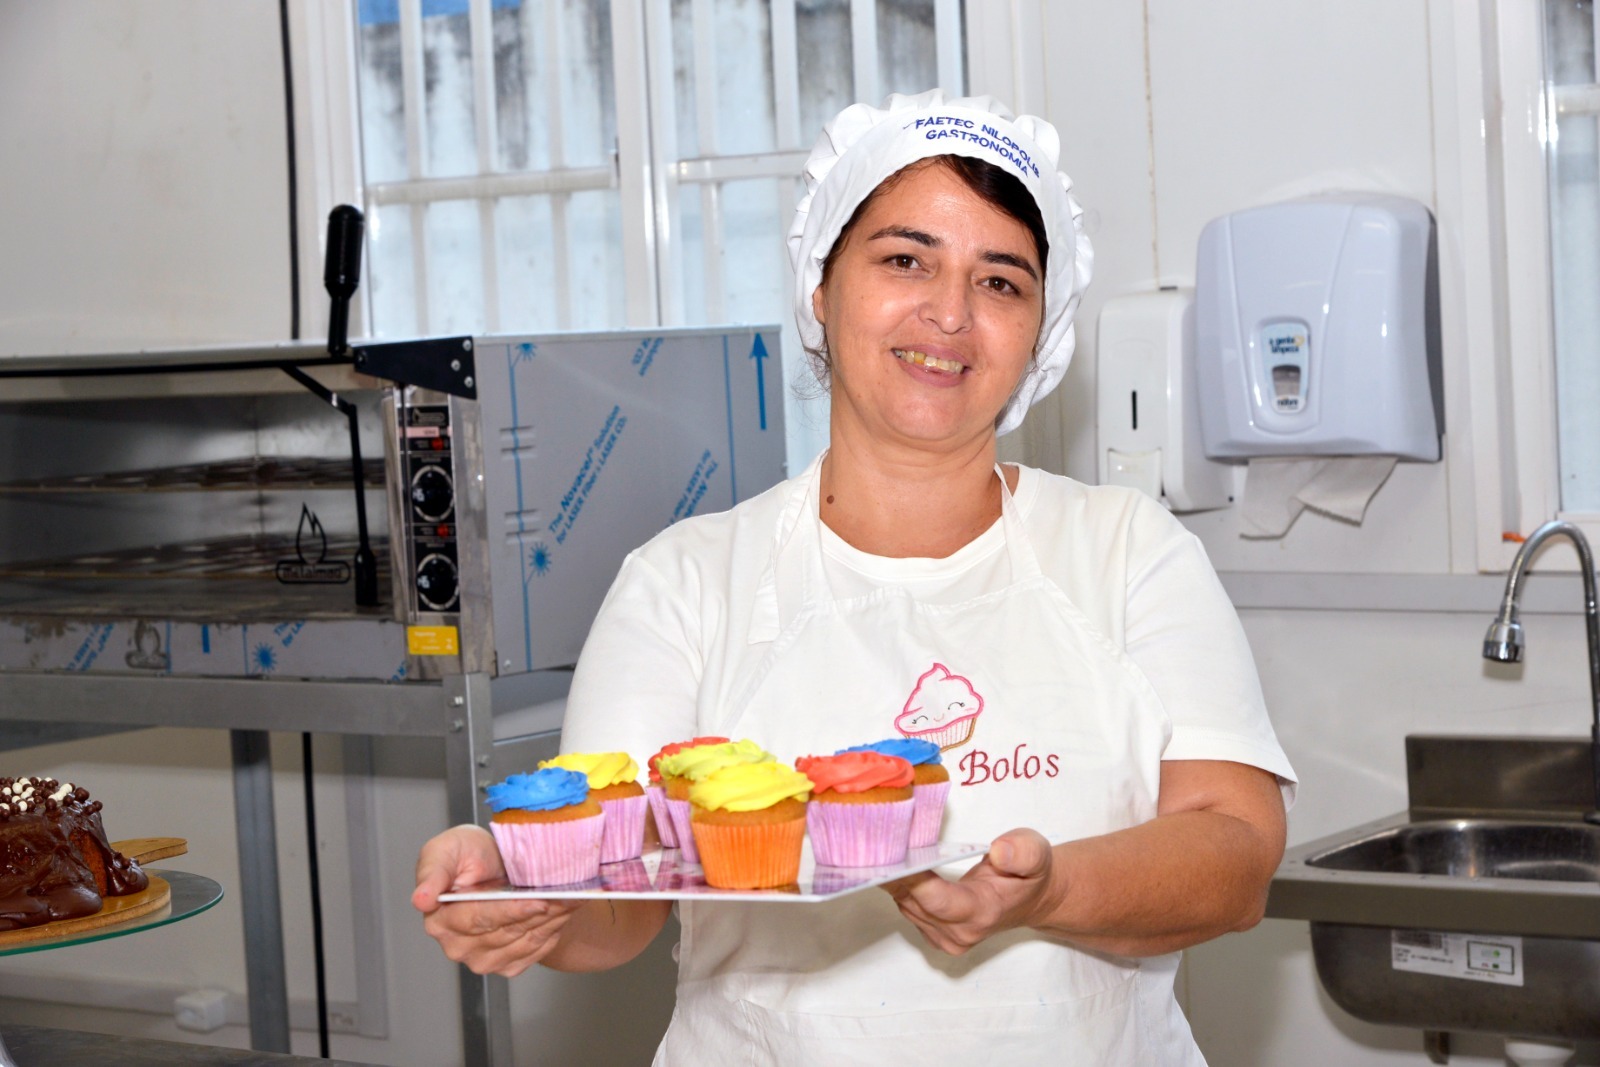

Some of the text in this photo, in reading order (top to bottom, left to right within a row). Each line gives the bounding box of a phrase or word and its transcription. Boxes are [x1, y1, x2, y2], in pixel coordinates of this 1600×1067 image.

[914, 116, 1041, 179] FAETEC NILOPOLIS
[925, 129, 1029, 178] GASTRONOMIA
[548, 512, 563, 533] The
[594, 404, 621, 449] Solution
[564, 496, 584, 530] LASER
[581, 471, 597, 498] Fiber
[598, 431, 617, 466] LASER
[958, 743, 1060, 786] Bolos
